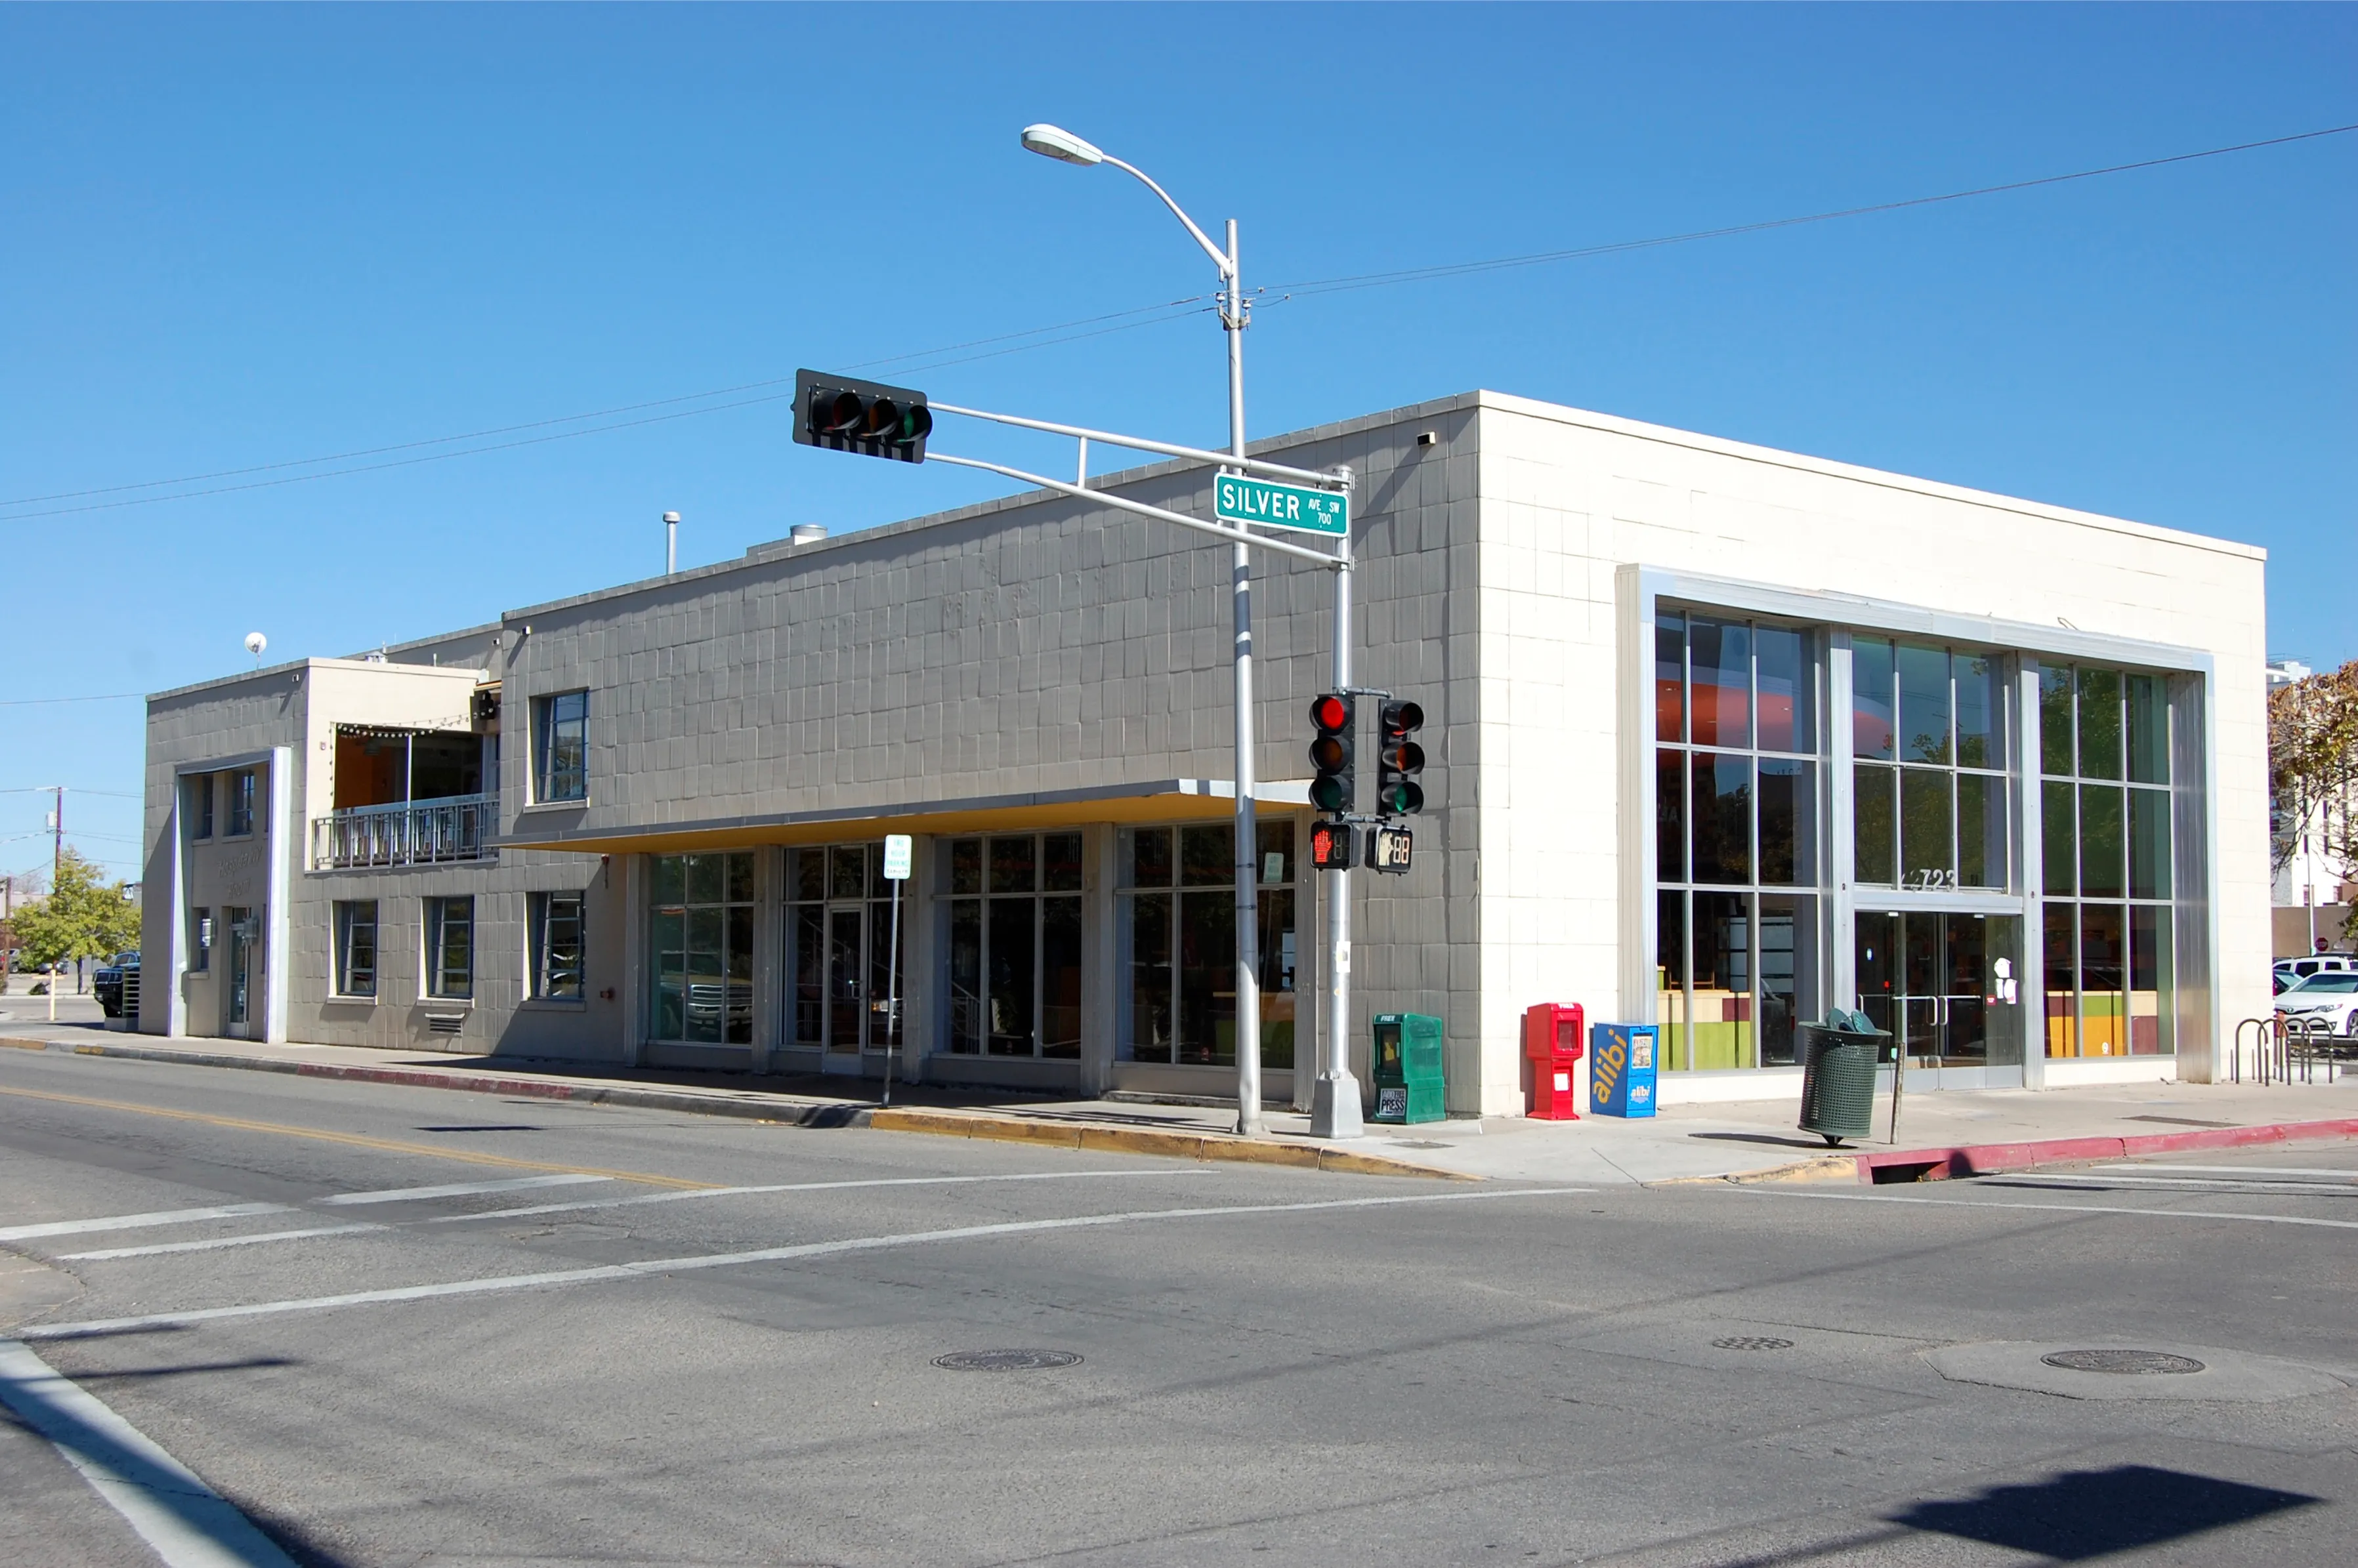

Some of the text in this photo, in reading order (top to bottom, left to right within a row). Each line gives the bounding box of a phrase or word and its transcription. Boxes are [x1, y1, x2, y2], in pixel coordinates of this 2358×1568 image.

[1222, 484, 1340, 520] SILVER AVE SW
[1318, 512, 1332, 526] 700
[1920, 869, 1956, 892] 723
[1593, 1028, 1628, 1104] alibi
[1630, 1085, 1651, 1098] alibi
[1381, 1099, 1405, 1111] PRESS
